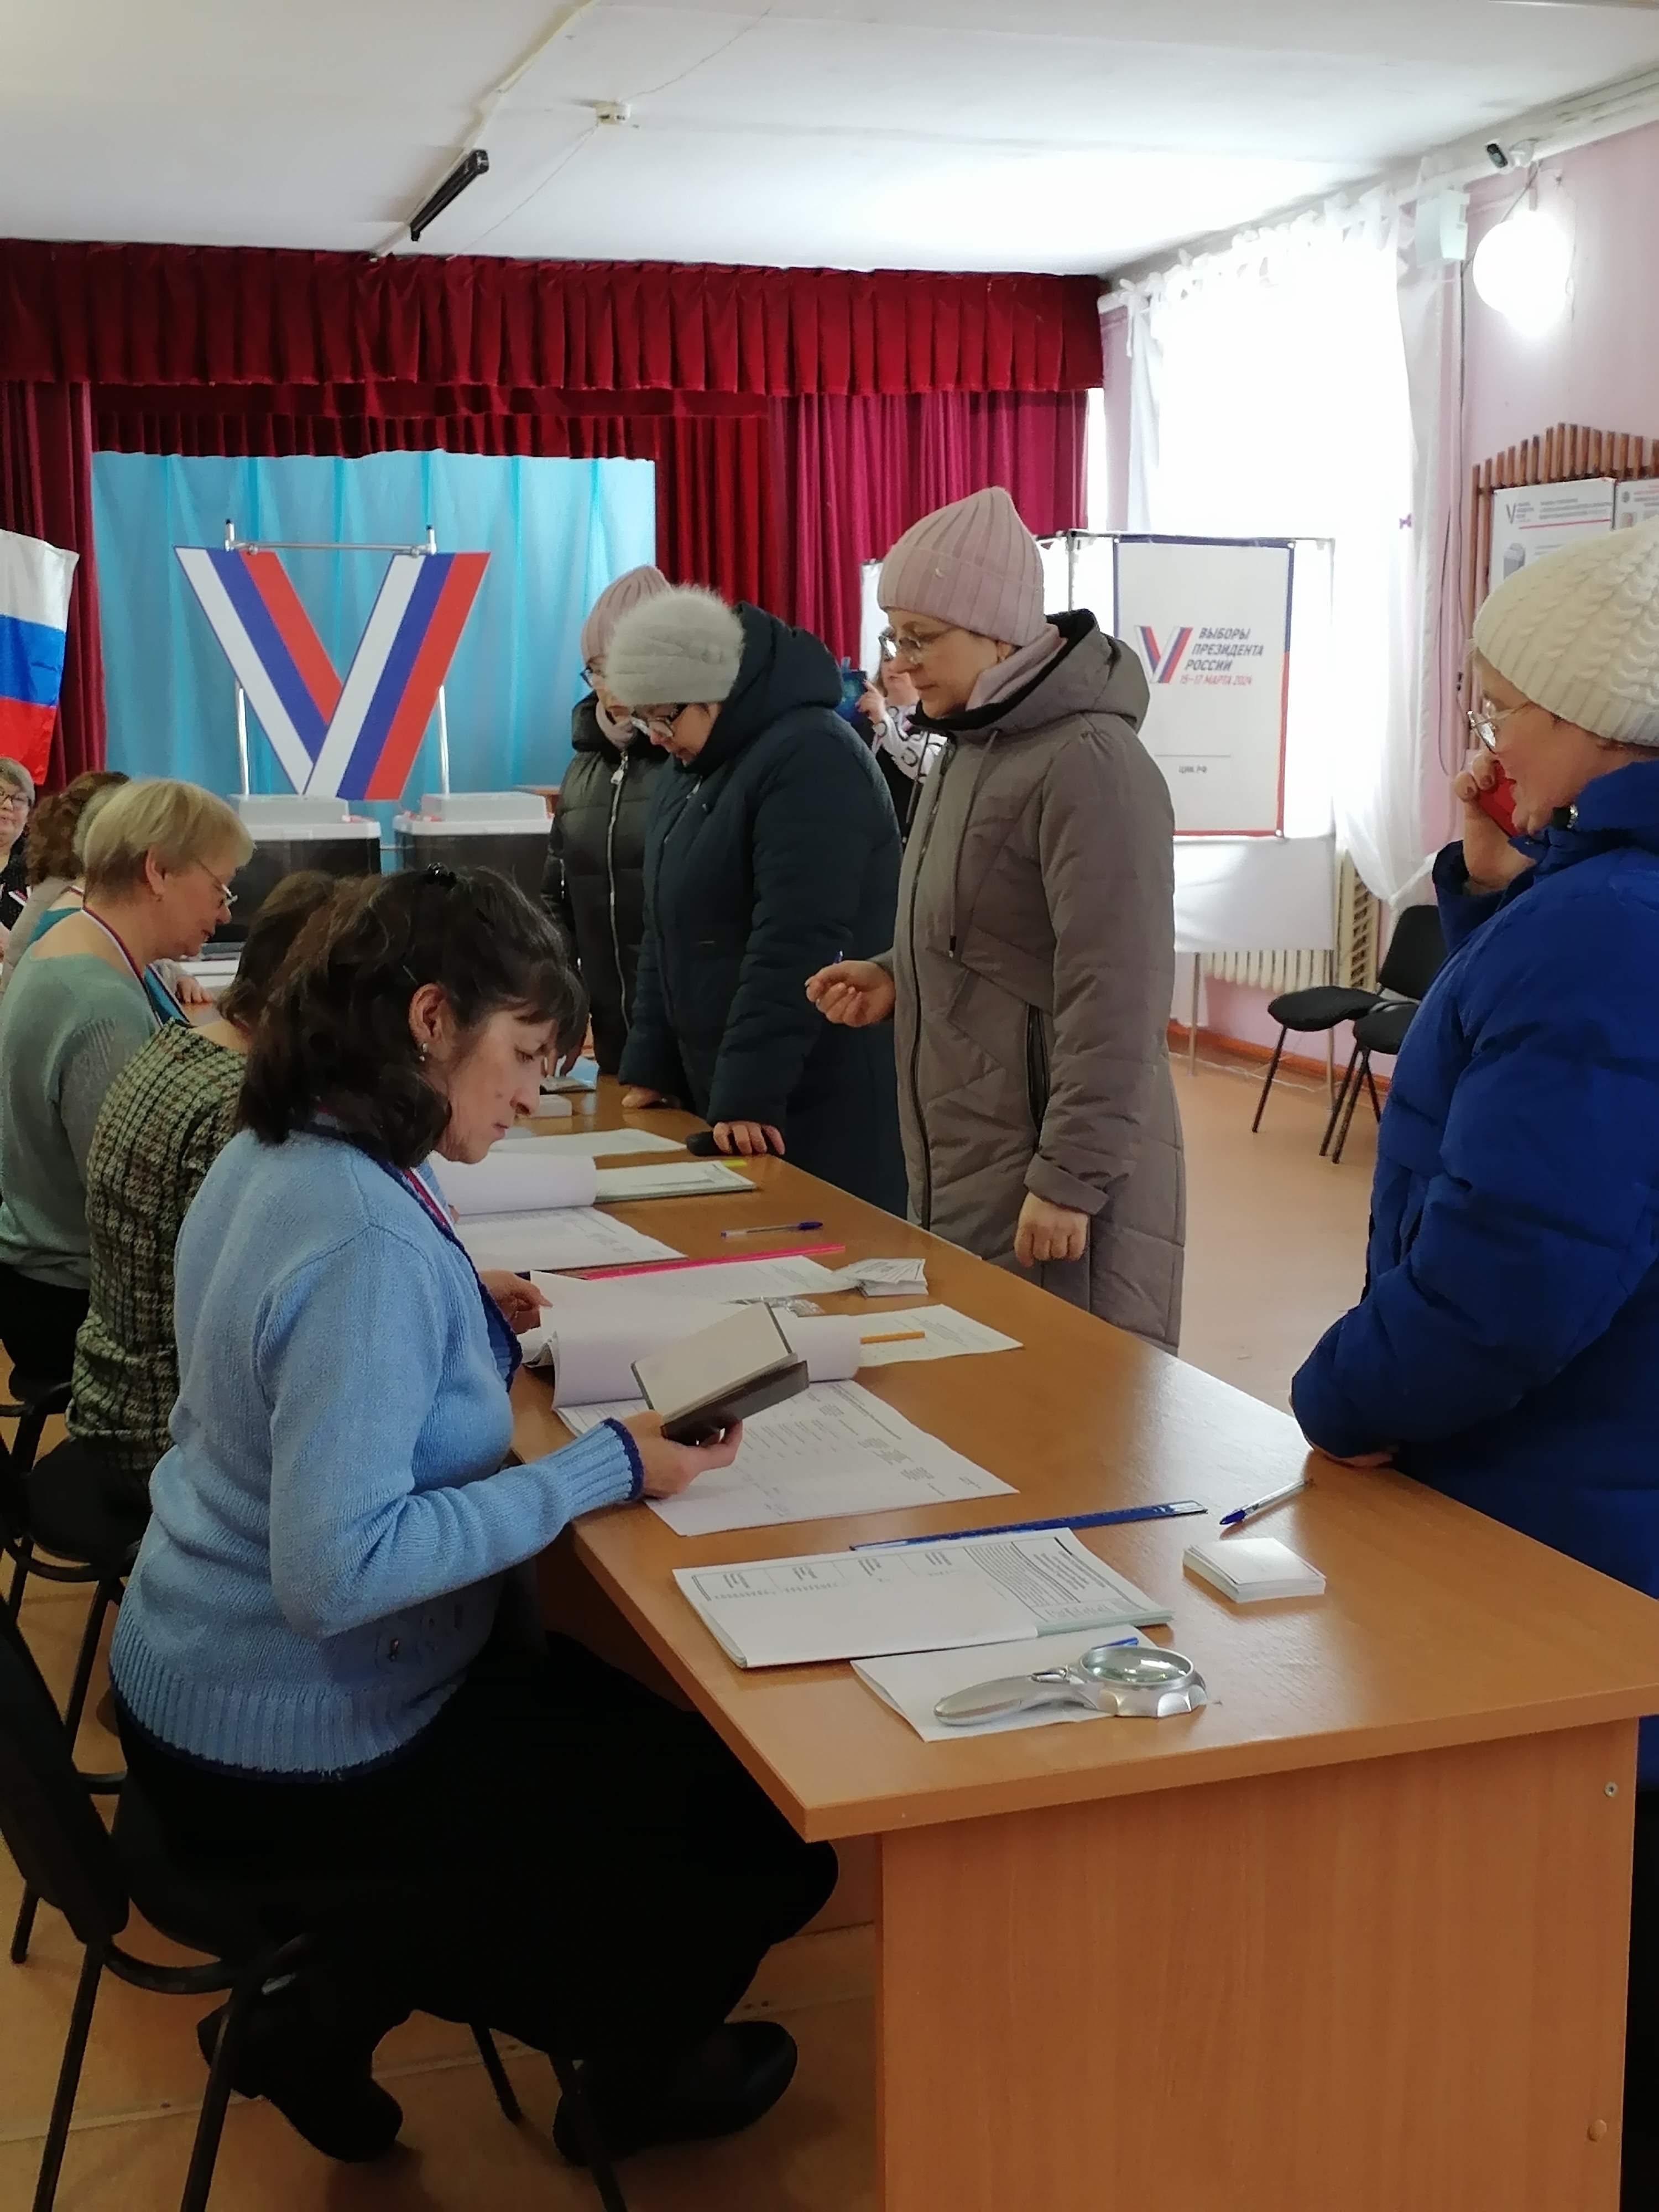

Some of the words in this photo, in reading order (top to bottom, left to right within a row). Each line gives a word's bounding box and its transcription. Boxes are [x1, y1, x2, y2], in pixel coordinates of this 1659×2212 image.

[1198, 627, 1251, 640] ВЫБОРЫ
[1191, 643, 1264, 656] ПРЕЗИДЕНТА
[1185, 659, 1233, 671] РОССИИ
